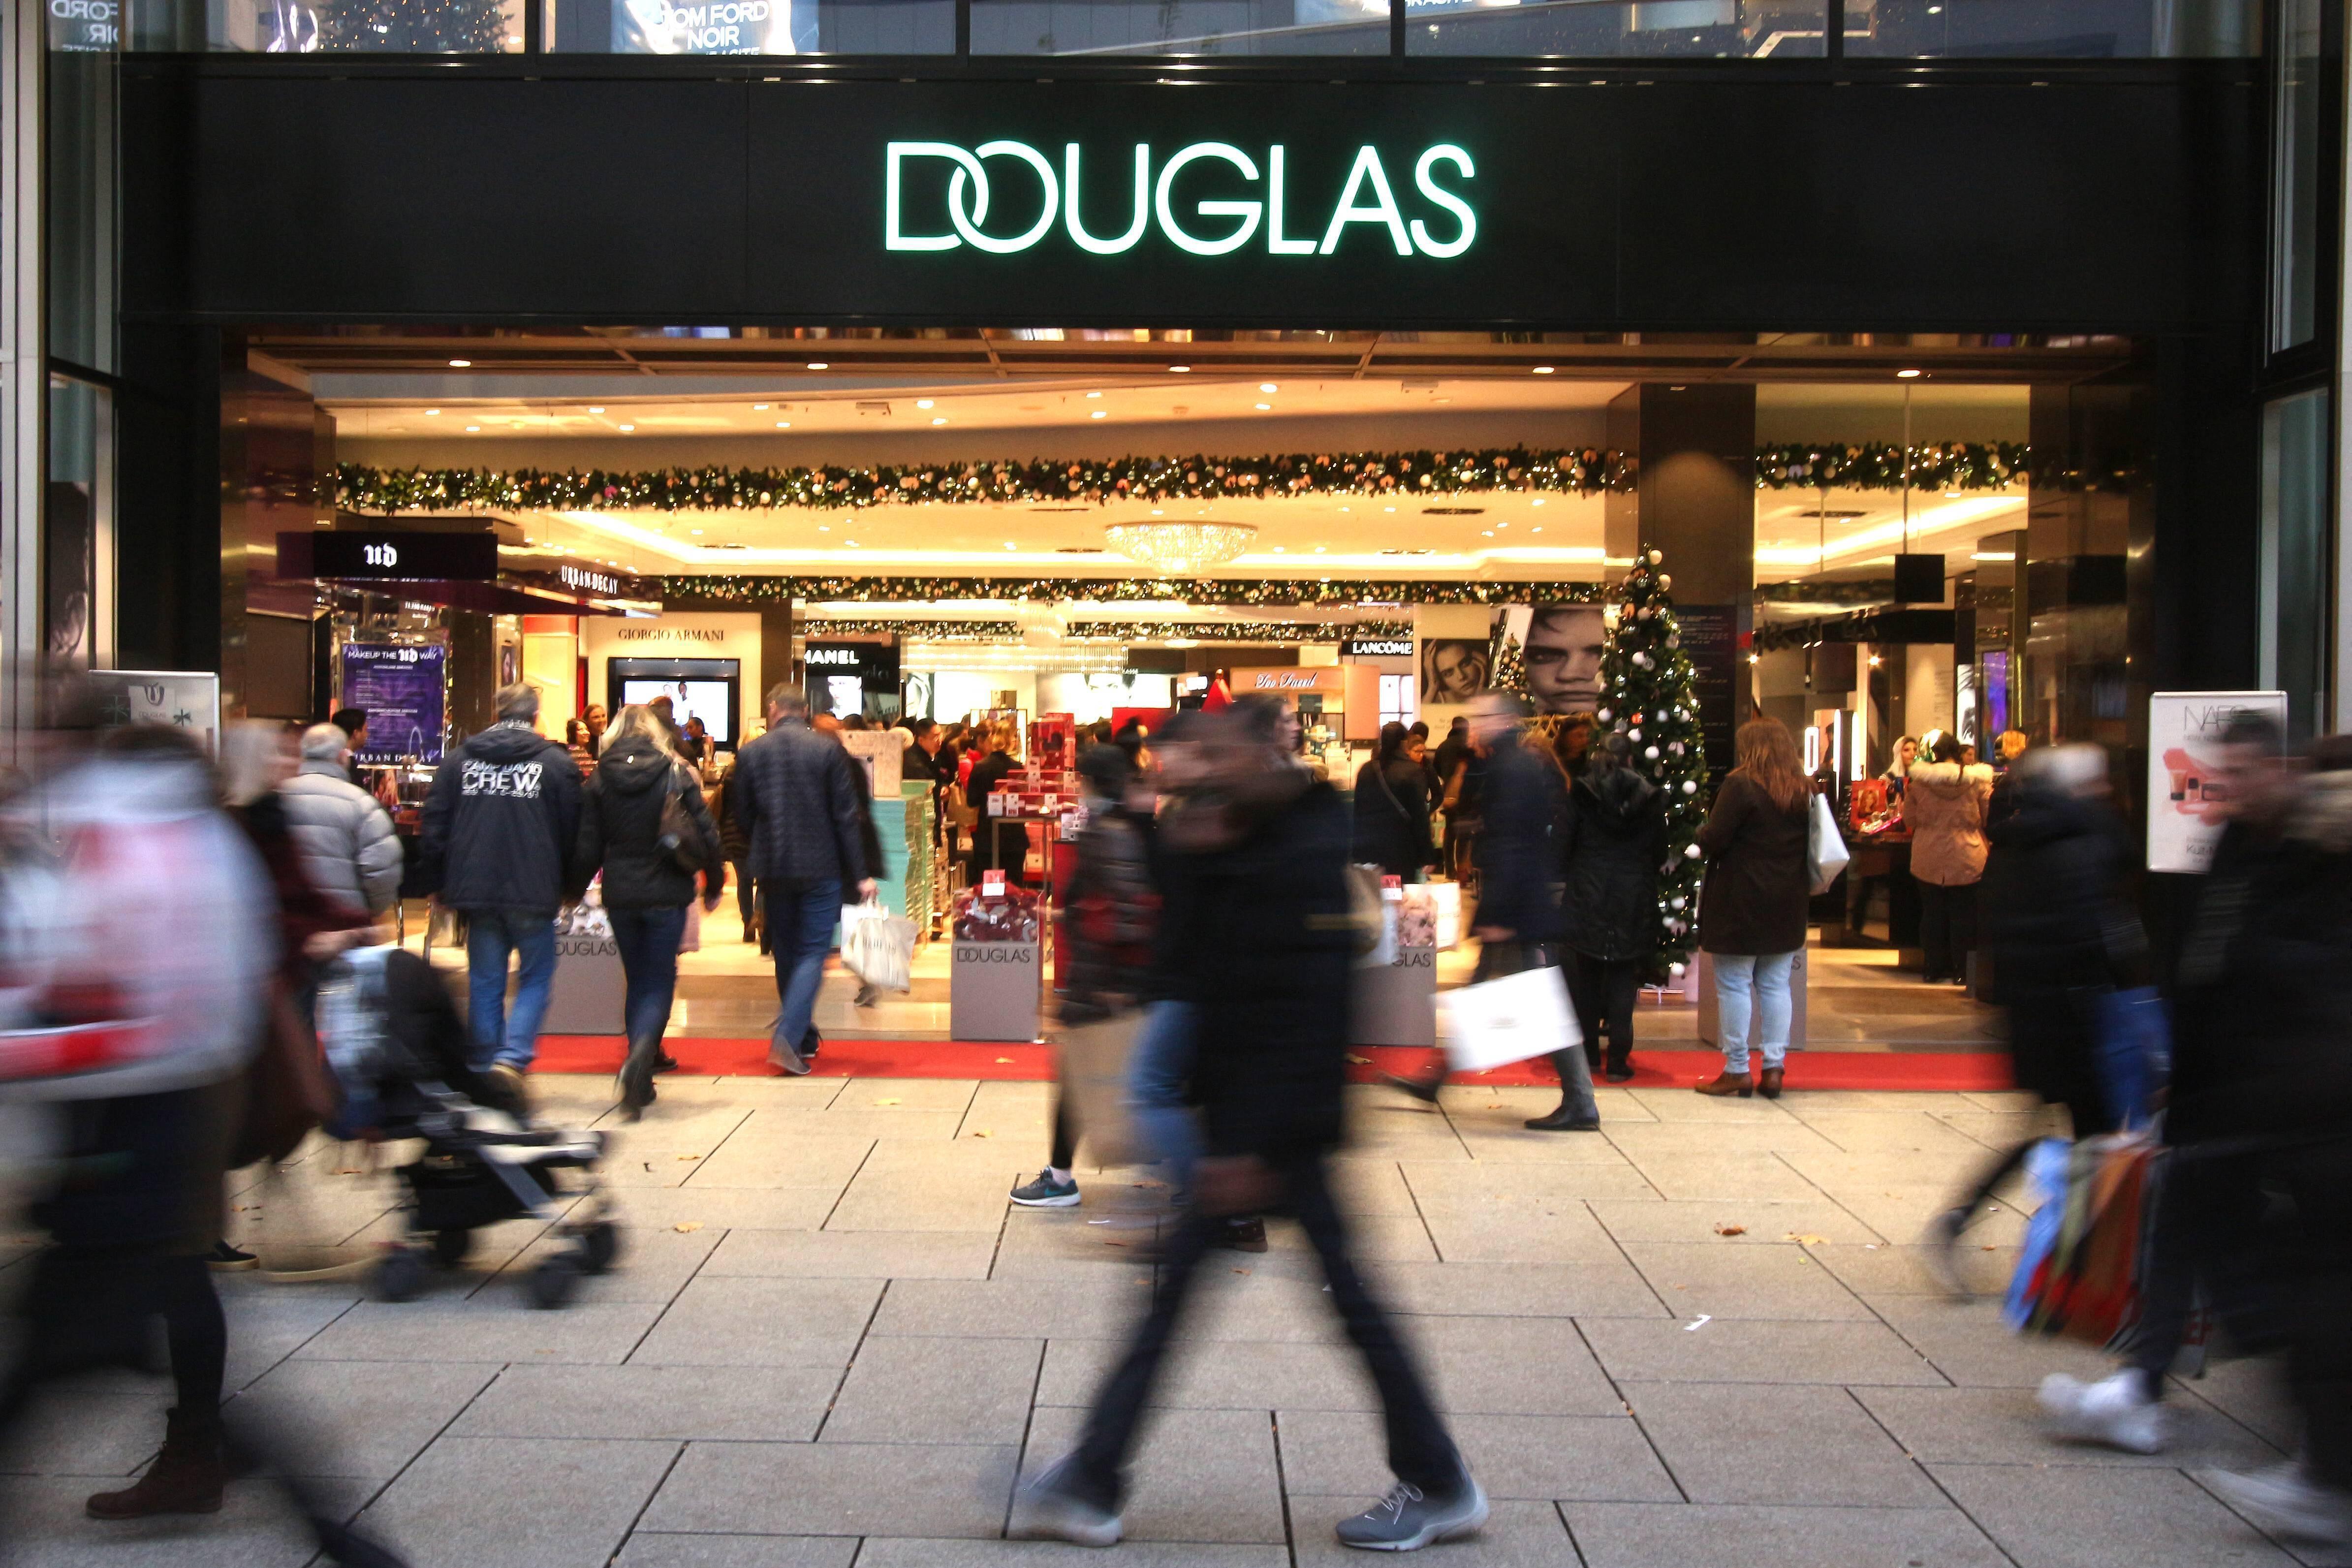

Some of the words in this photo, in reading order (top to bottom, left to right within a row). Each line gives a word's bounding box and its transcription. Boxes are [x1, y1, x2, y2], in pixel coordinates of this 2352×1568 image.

[710, 1, 769, 25] FORD
[688, 26, 740, 50] NOIR
[885, 140, 1477, 258] DOUGLAS
[561, 565, 591, 590] URBAN
[592, 573, 618, 595] DECAY
[618, 629, 670, 640] GIORGIO
[675, 629, 724, 641] ARMANI
[348, 651, 380, 659] MAKEUP
[381, 651, 397, 659] THE
[1352, 640, 1412, 655] LANCÔME
[804, 650, 859, 664] HANEL
[462, 771, 540, 791] CREW
[554, 941, 617, 956] OUGLAS
[957, 947, 1030, 963] DOUGLAS
